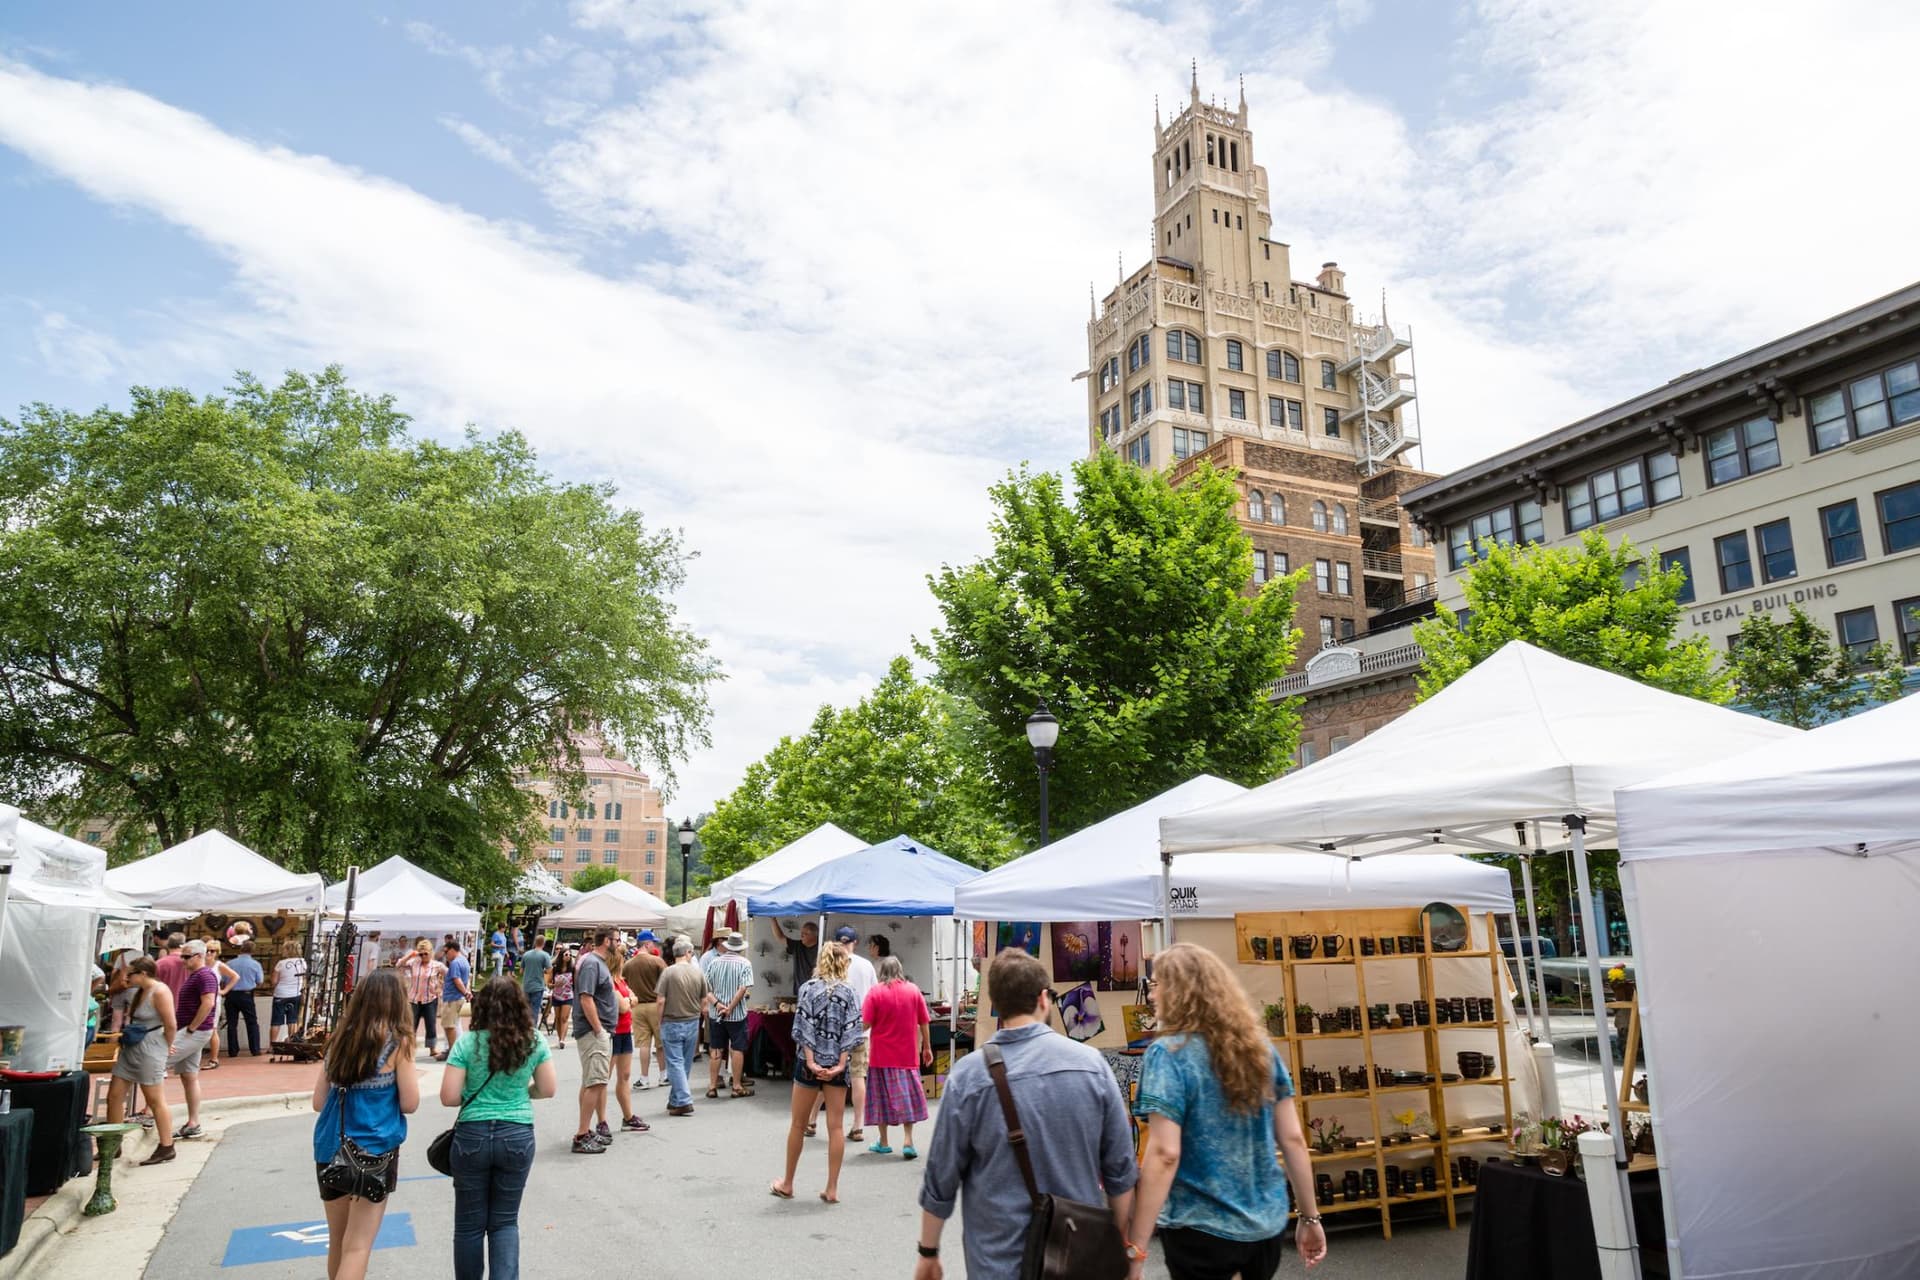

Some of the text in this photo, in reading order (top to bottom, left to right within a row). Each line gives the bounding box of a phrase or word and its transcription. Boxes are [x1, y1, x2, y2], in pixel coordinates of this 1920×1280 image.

[1692, 583, 1838, 626] LEGAL BUILDING
[1170, 887, 1197, 899] QUIK
[1169, 899, 1199, 909] SHADE
